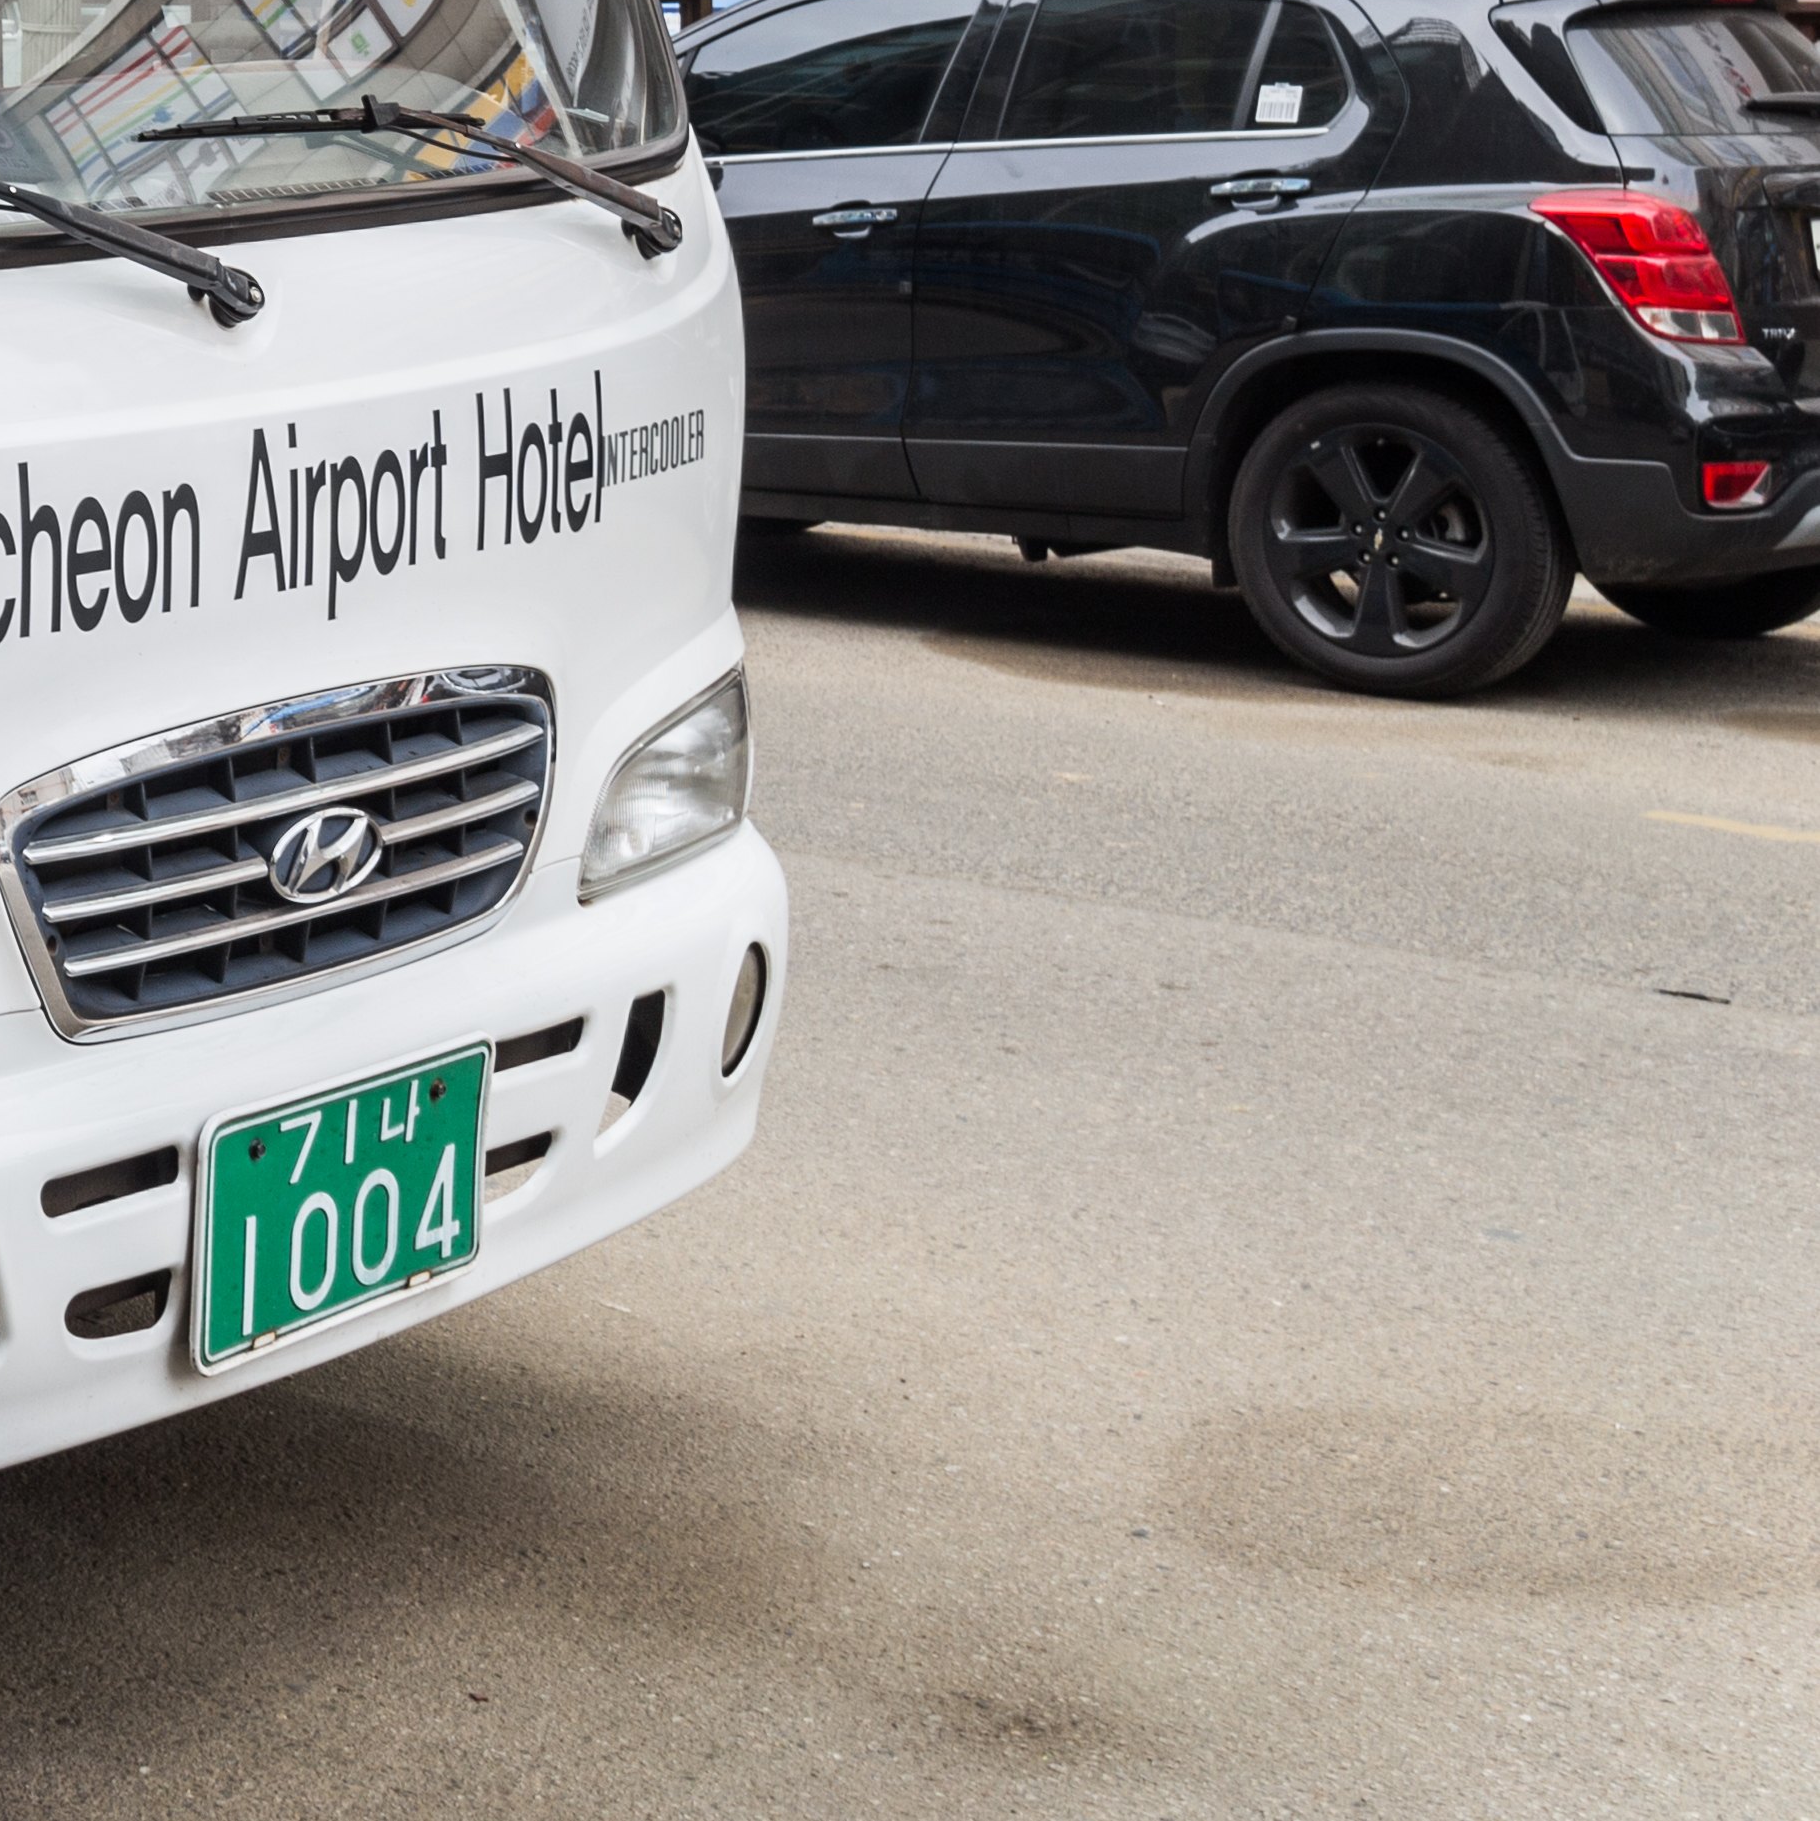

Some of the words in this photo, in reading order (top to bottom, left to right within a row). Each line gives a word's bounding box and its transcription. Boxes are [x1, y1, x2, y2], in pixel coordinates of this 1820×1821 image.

[233, 407, 449, 621] Airport
[475, 368, 605, 553] Hotel
[601, 409, 706, 490] INTERCOOLER
[278, 1078, 421, 1185] 71나
[241, 1142, 461, 1338] 1004
